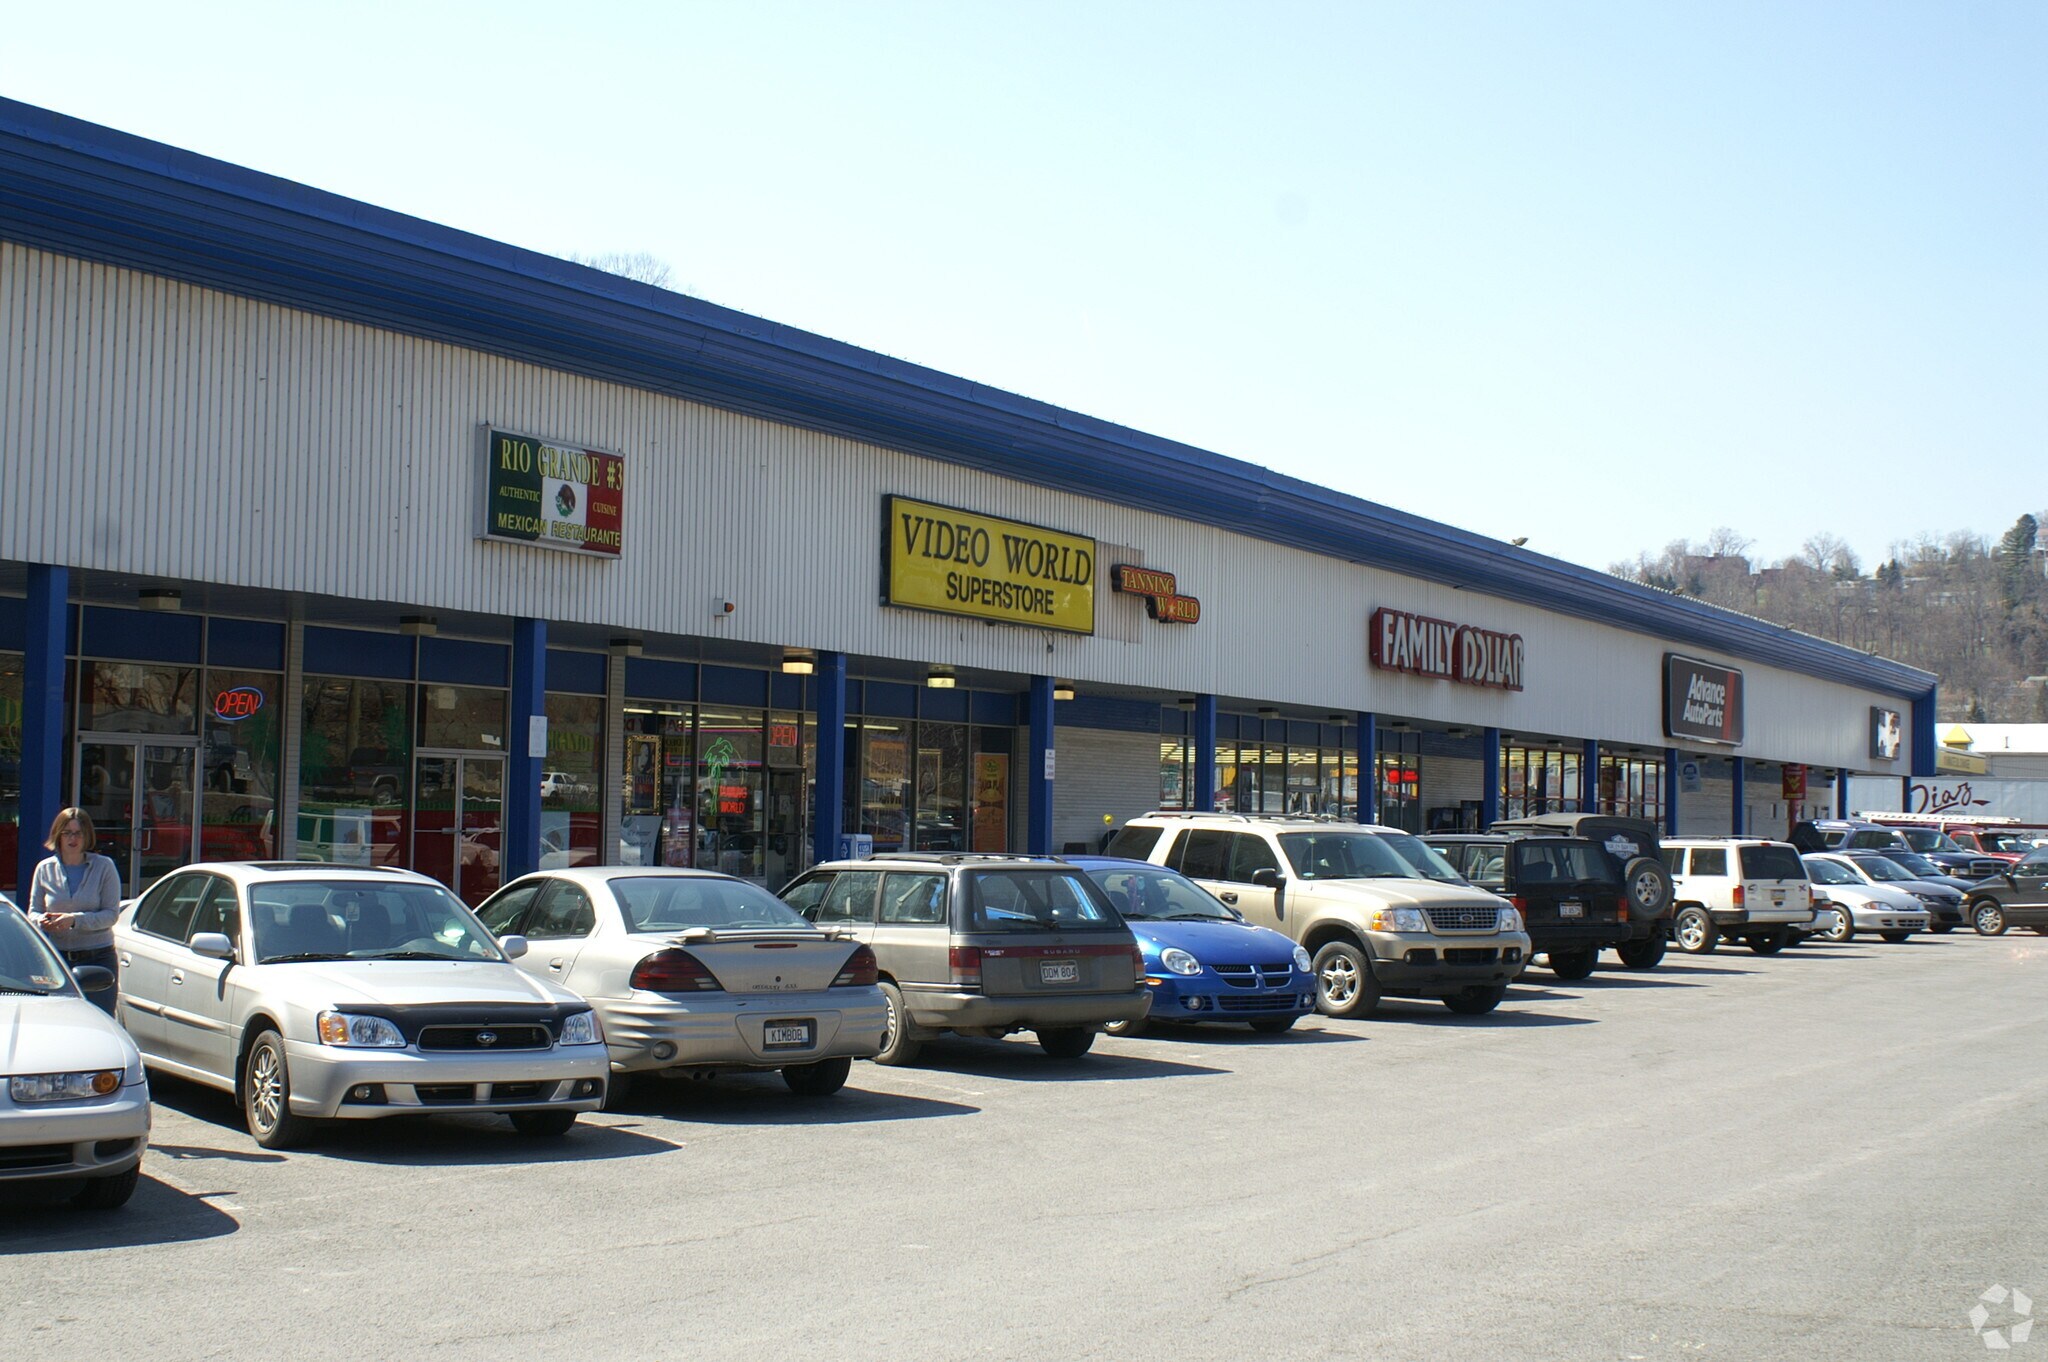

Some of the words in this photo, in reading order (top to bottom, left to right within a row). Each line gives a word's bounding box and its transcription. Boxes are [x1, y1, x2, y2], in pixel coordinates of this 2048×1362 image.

[501, 438, 531, 473] RIO
[537, 445, 600, 486] GRANDE
[607, 460, 623, 491] #3
[499, 485, 540, 503] AUTHENTIC
[592, 502, 617, 517] CUISINE
[498, 512, 547, 535] MEXICAN
[551, 521, 621, 547] RESTAURANTE
[902, 513, 990, 567] VIDEO
[1003, 534, 1092, 586] WORLD
[947, 571, 1055, 615] SUPERSTORE
[1122, 570, 1174, 595] TANNING
[1382, 613, 1457, 675] FAMILY
[215, 691, 259, 715] OPEN
[1687, 673, 1726, 705] Advance
[719, 801, 744, 814] WORLD
